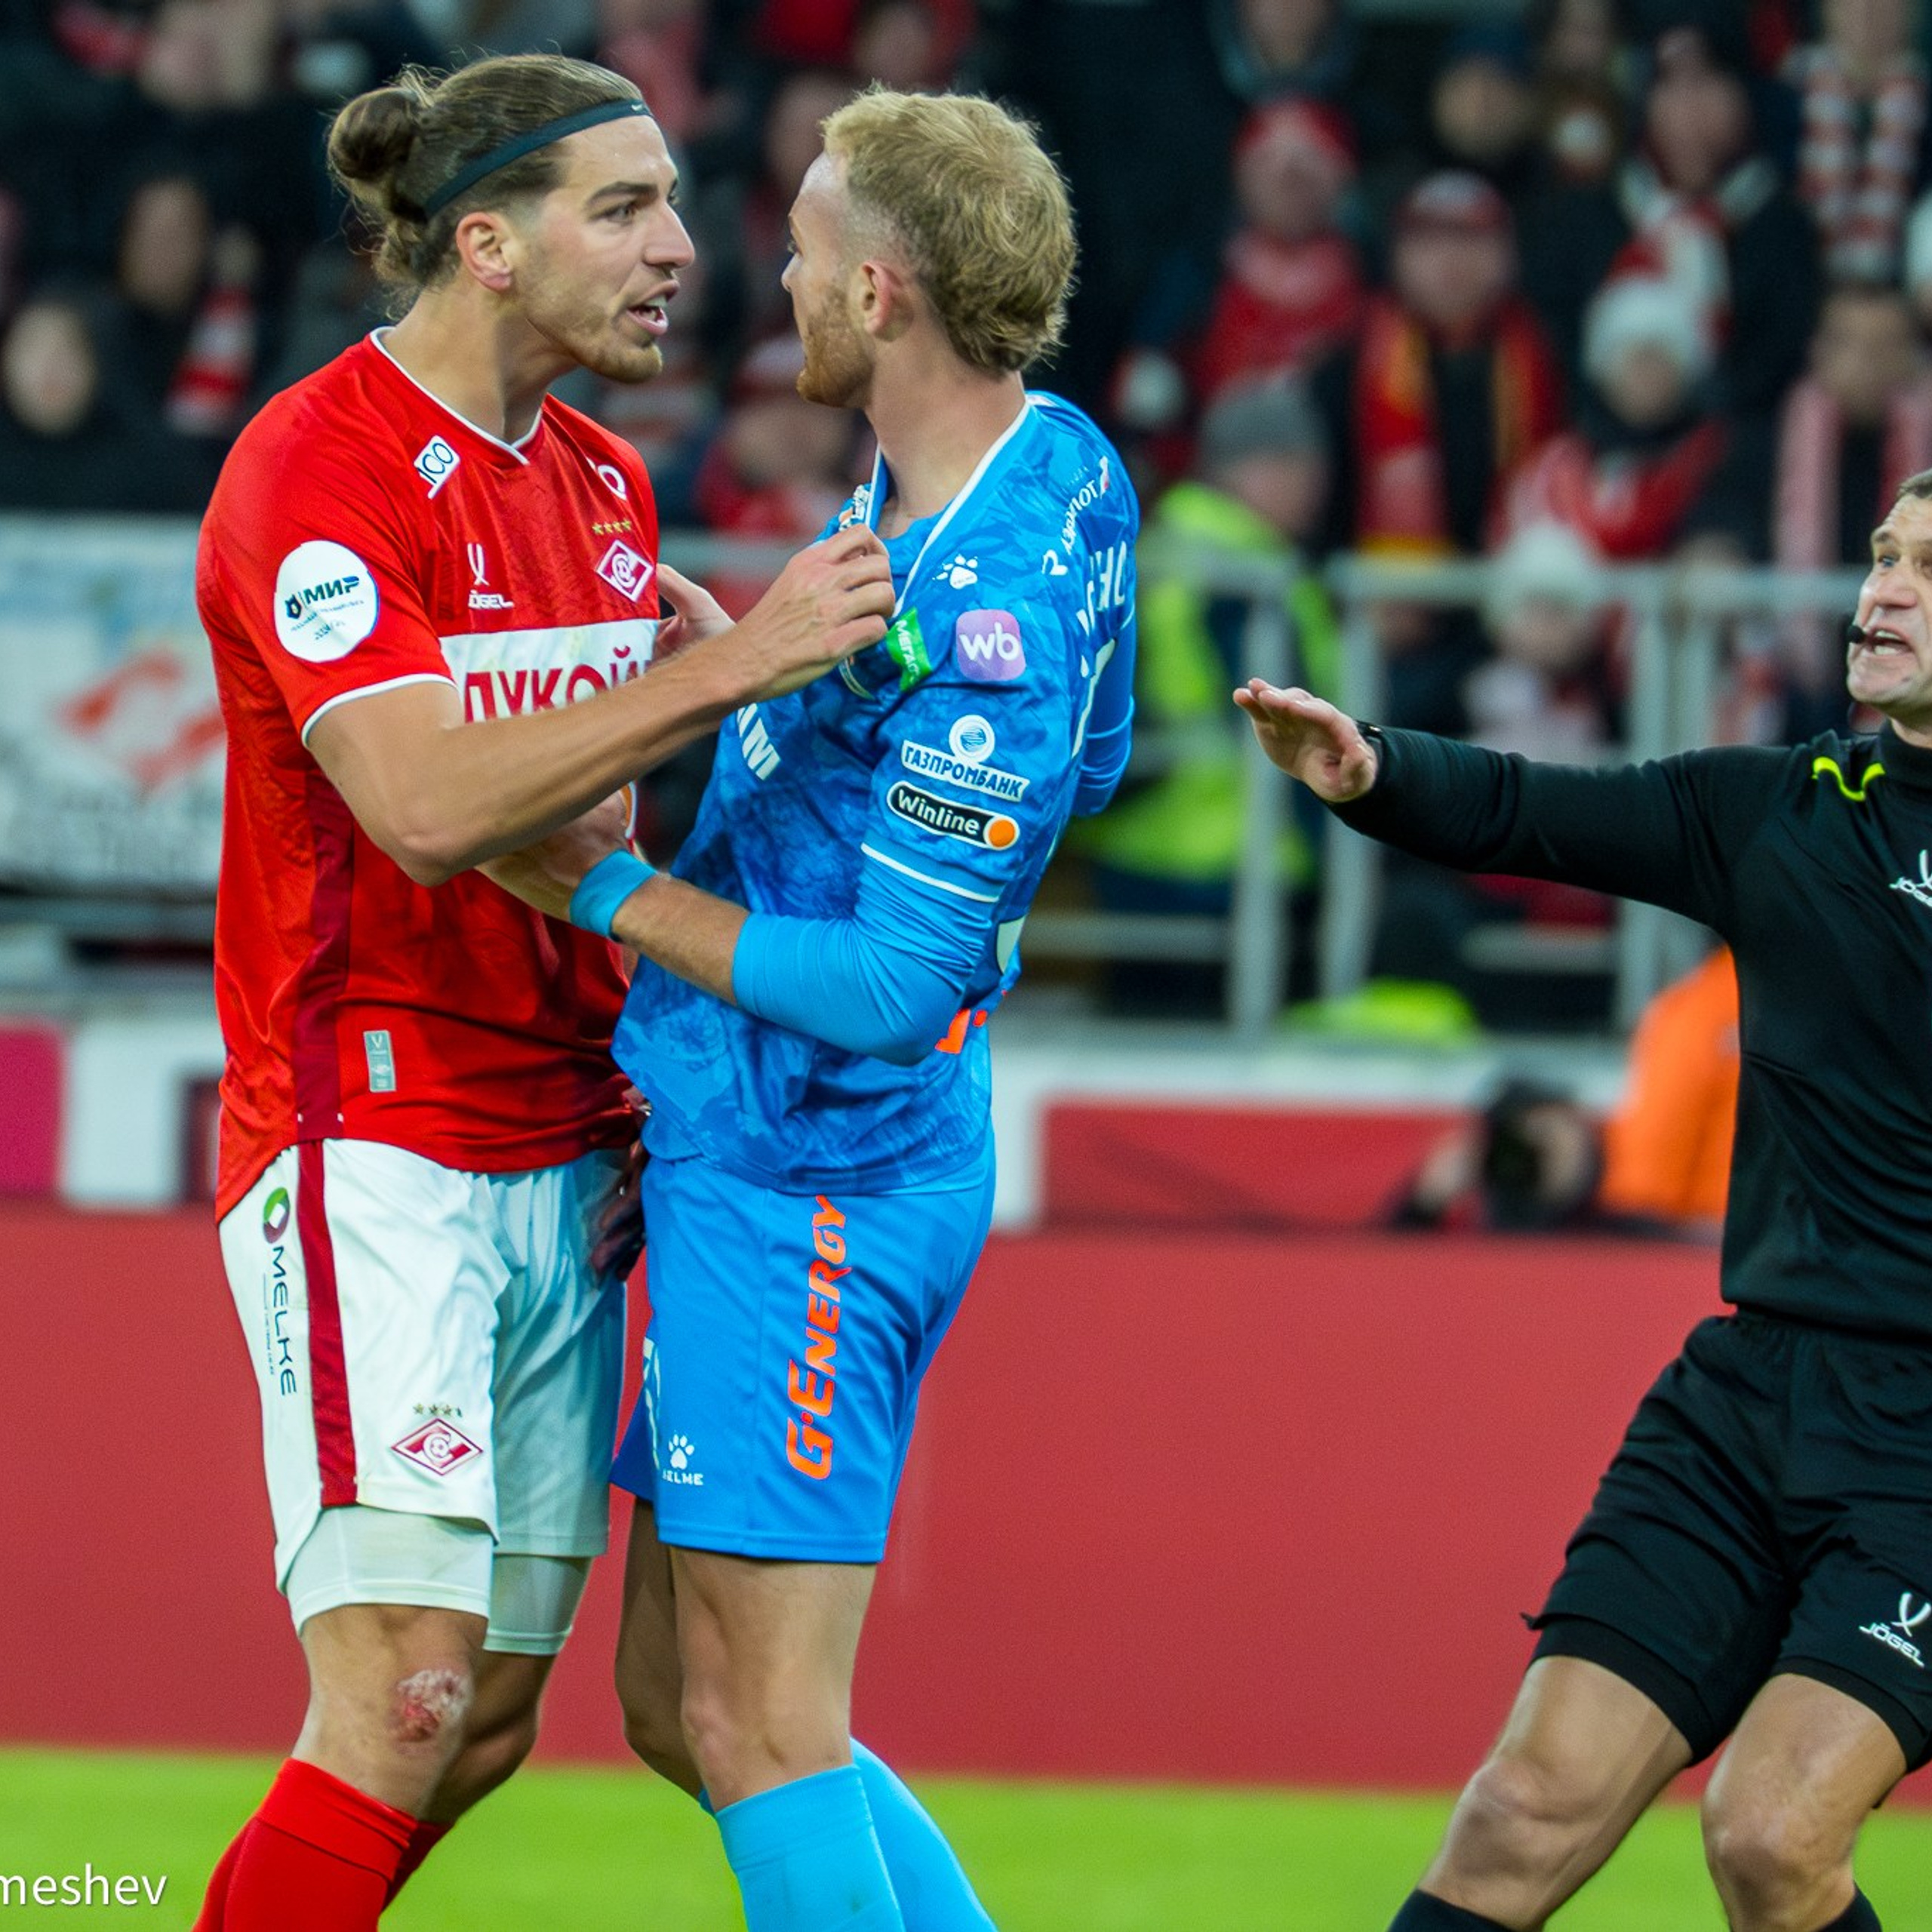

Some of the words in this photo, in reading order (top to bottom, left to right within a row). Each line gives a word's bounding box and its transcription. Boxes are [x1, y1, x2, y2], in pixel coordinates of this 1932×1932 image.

[303, 576, 360, 605] МИР
[959, 621, 1020, 660] wb
[464, 645, 654, 724] ЛУКОЙ
[905, 746, 1023, 798] ГАЗПРОМБАНК
[897, 789, 980, 835] Winline
[272, 1245, 297, 1396] MELKE
